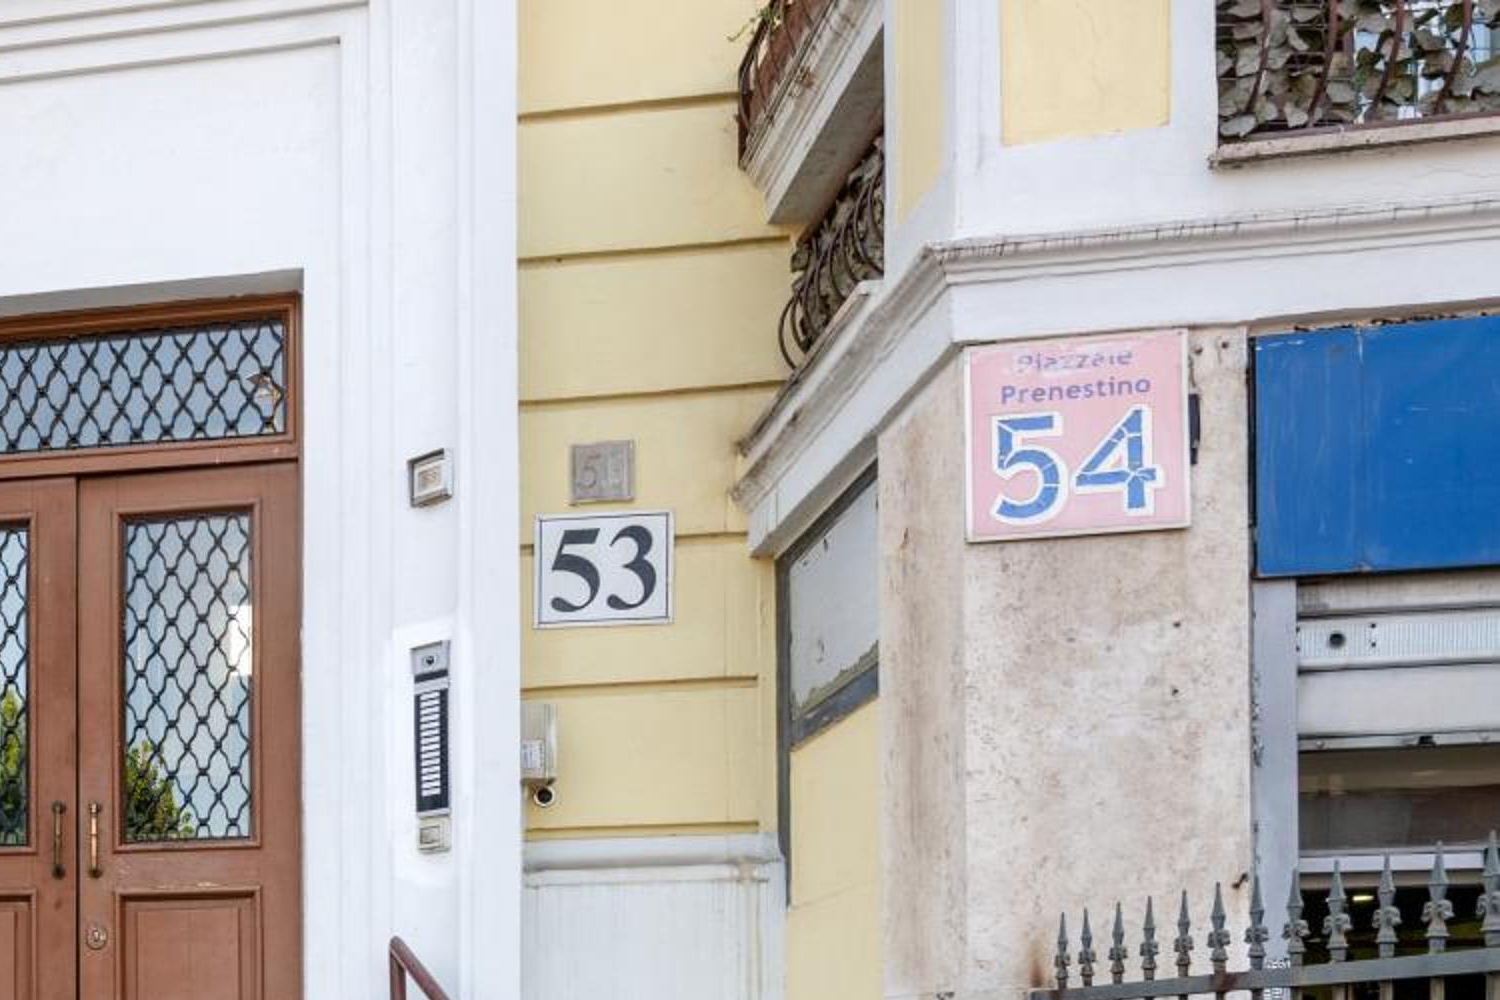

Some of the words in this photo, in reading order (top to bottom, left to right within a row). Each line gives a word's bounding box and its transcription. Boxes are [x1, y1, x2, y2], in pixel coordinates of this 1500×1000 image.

[1000, 377, 1152, 405] Prenestino
[993, 405, 1161, 523] 54
[550, 524, 657, 613] 53
